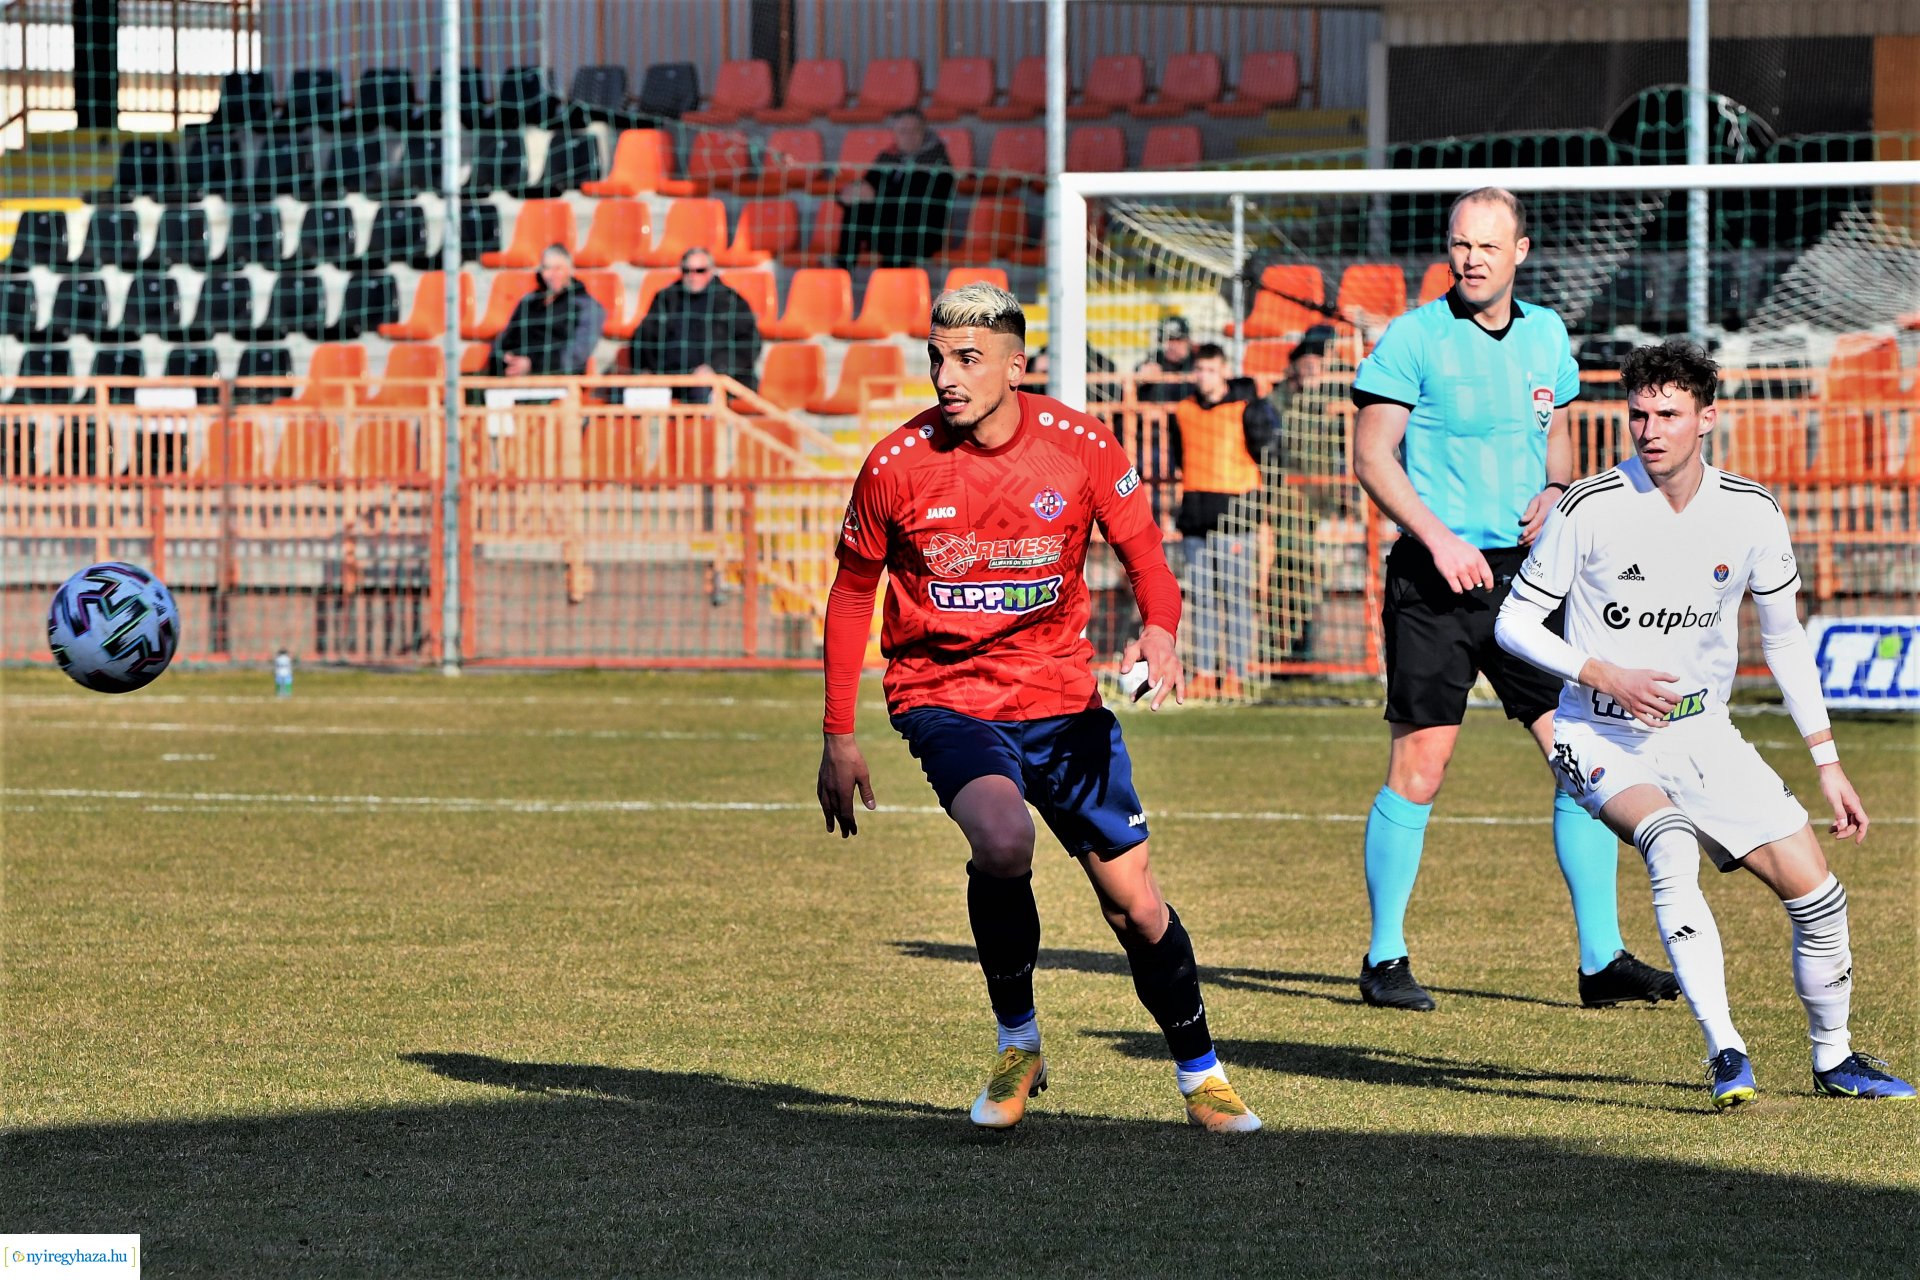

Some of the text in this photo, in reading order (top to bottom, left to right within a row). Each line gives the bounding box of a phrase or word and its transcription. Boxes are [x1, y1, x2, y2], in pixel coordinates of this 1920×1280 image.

[926, 506, 957, 520] JAKO
[975, 535, 1066, 561] REVESZ
[1618, 573, 1645, 581] adidas
[1666, 930, 1703, 945] adidas
